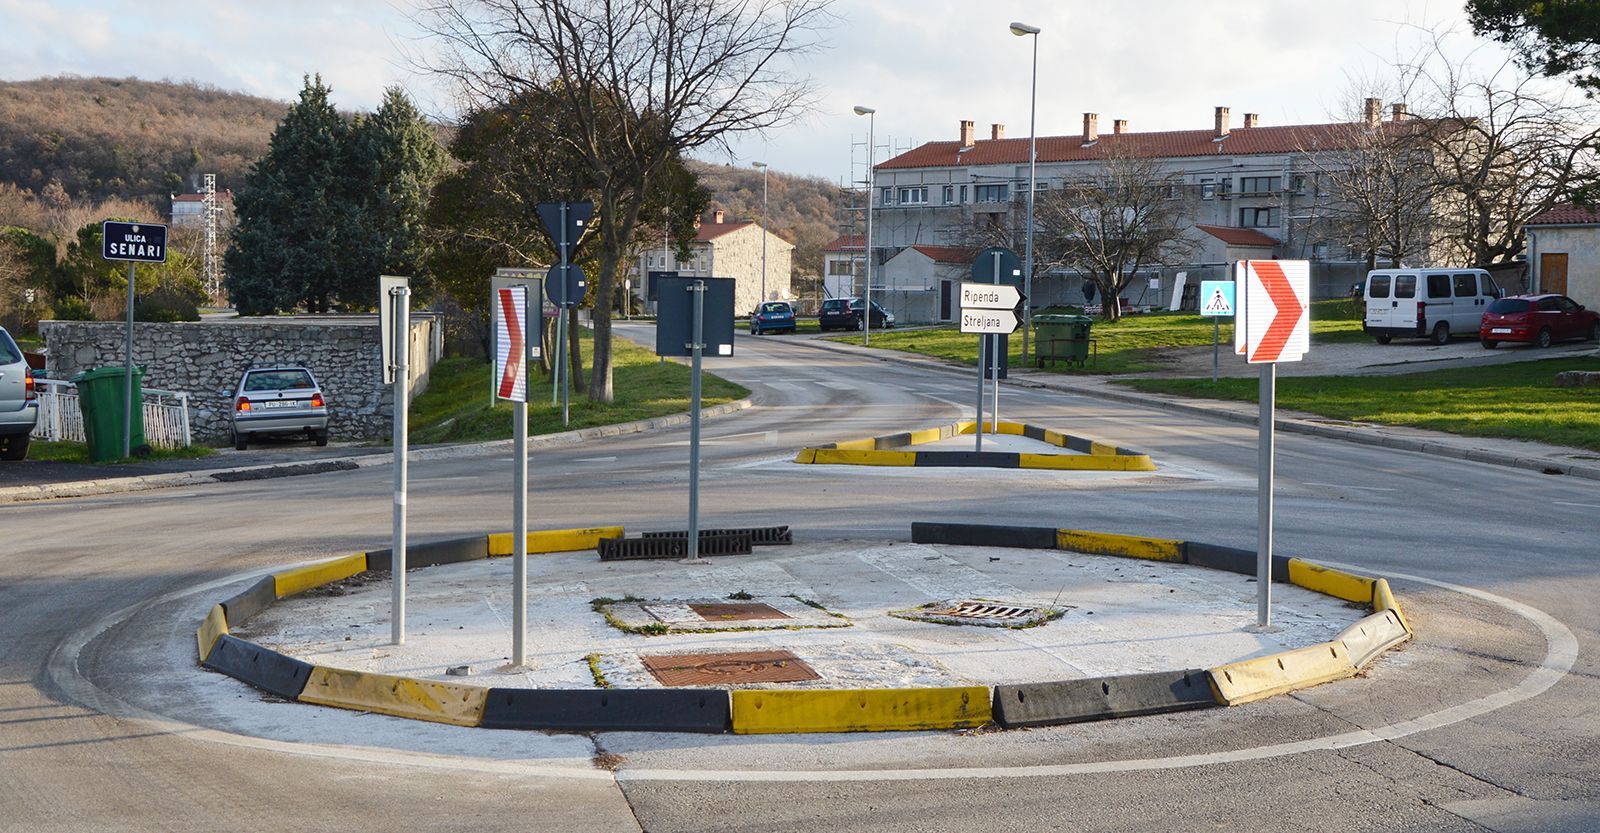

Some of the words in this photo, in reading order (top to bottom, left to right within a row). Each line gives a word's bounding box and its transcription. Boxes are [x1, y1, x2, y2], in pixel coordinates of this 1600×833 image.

[125, 234, 146, 243] ULICA
[110, 243, 161, 257] SENARI
[964, 290, 999, 304] Ripenda
[964, 315, 1001, 330] Streljana
